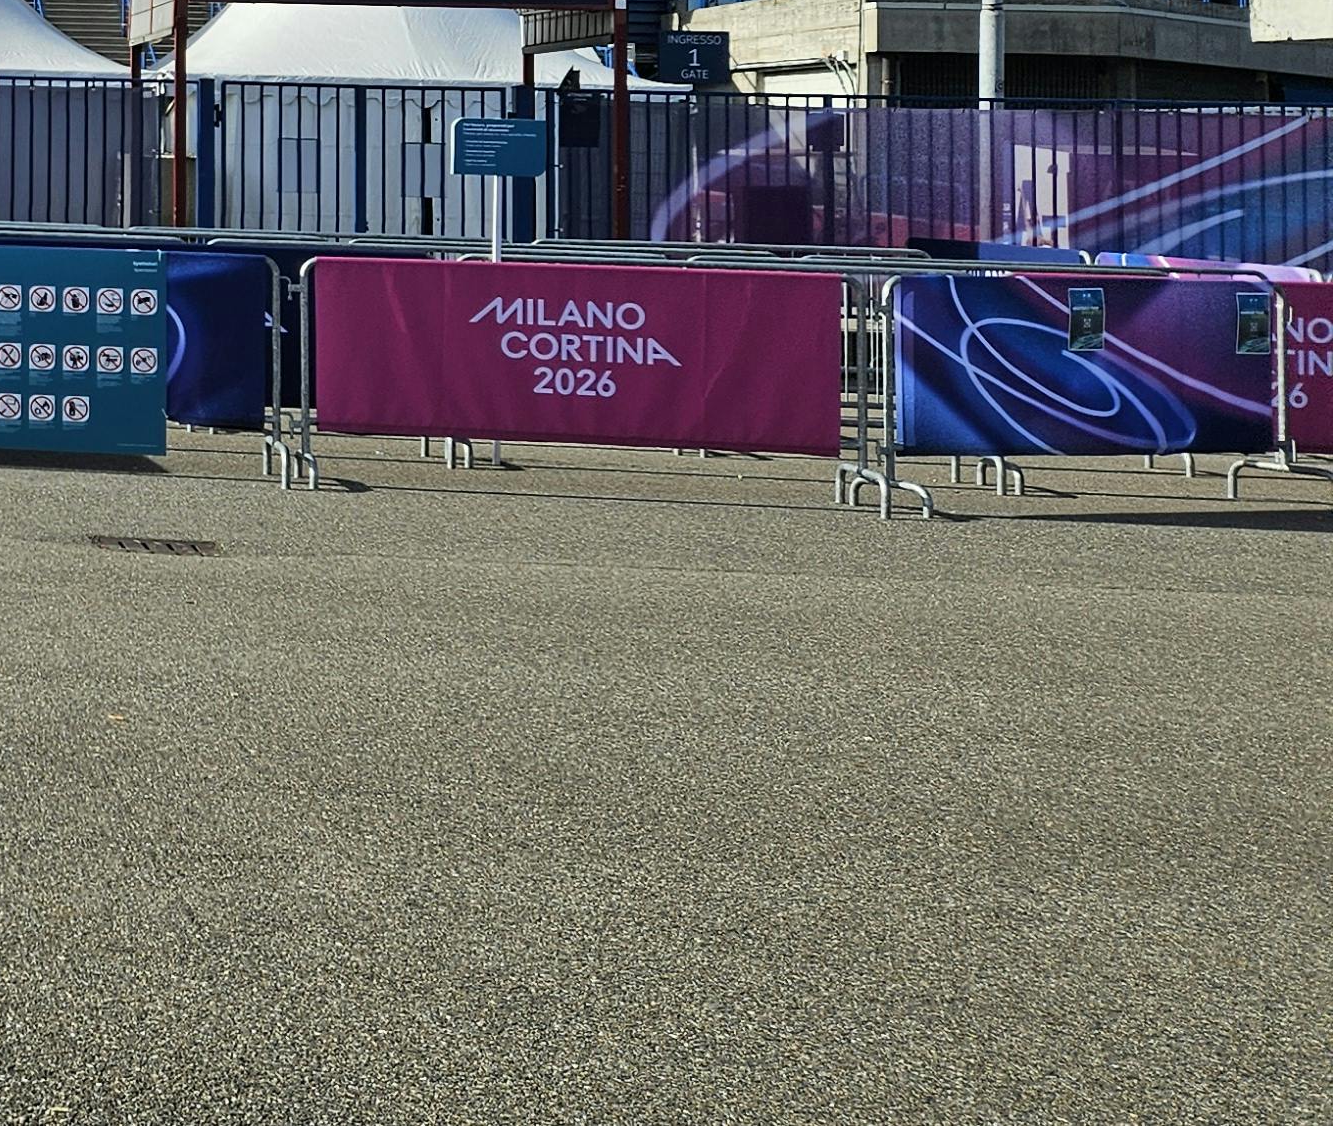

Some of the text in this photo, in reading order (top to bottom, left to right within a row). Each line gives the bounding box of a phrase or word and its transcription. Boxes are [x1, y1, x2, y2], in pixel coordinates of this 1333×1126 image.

[667, 34, 722, 45] INGRESSO
[688, 48, 701, 67] 1
[680, 68, 709, 79] GATE
[468, 296, 646, 330] MILANO
[500, 331, 682, 367] CORTINA
[533, 366, 617, 398] 2026
